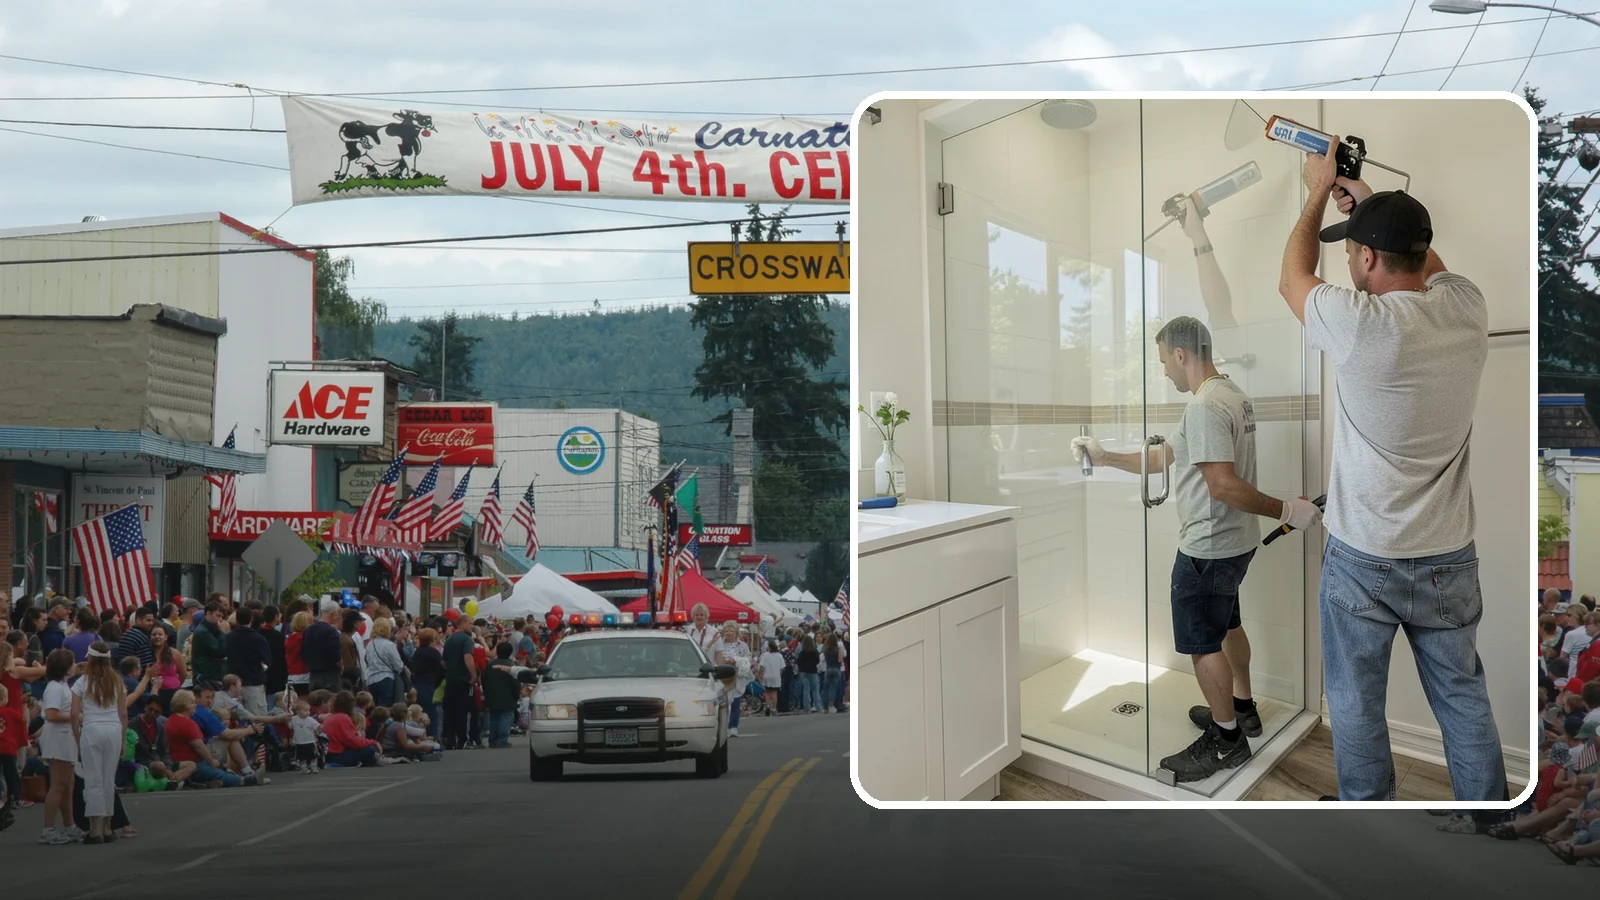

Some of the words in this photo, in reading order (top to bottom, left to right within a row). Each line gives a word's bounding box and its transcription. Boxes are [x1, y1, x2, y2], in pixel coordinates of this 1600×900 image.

[481, 140, 605, 193] JULY
[632, 148, 746, 198] 4th.
[697, 254, 850, 280] CROSSWA
[282, 379, 374, 420] ACE
[405, 409, 452, 421] CEDAR
[461, 409, 485, 421] LOG
[283, 421, 371, 437] Hardware
[354, 467, 384, 479] Simpl
[95, 485, 124, 494] Vincent
[126, 486, 136, 494] de
[137, 486, 155, 495] Paul
[688, 526, 741, 535] CRNATION
[699, 535, 730, 543] GLASS
